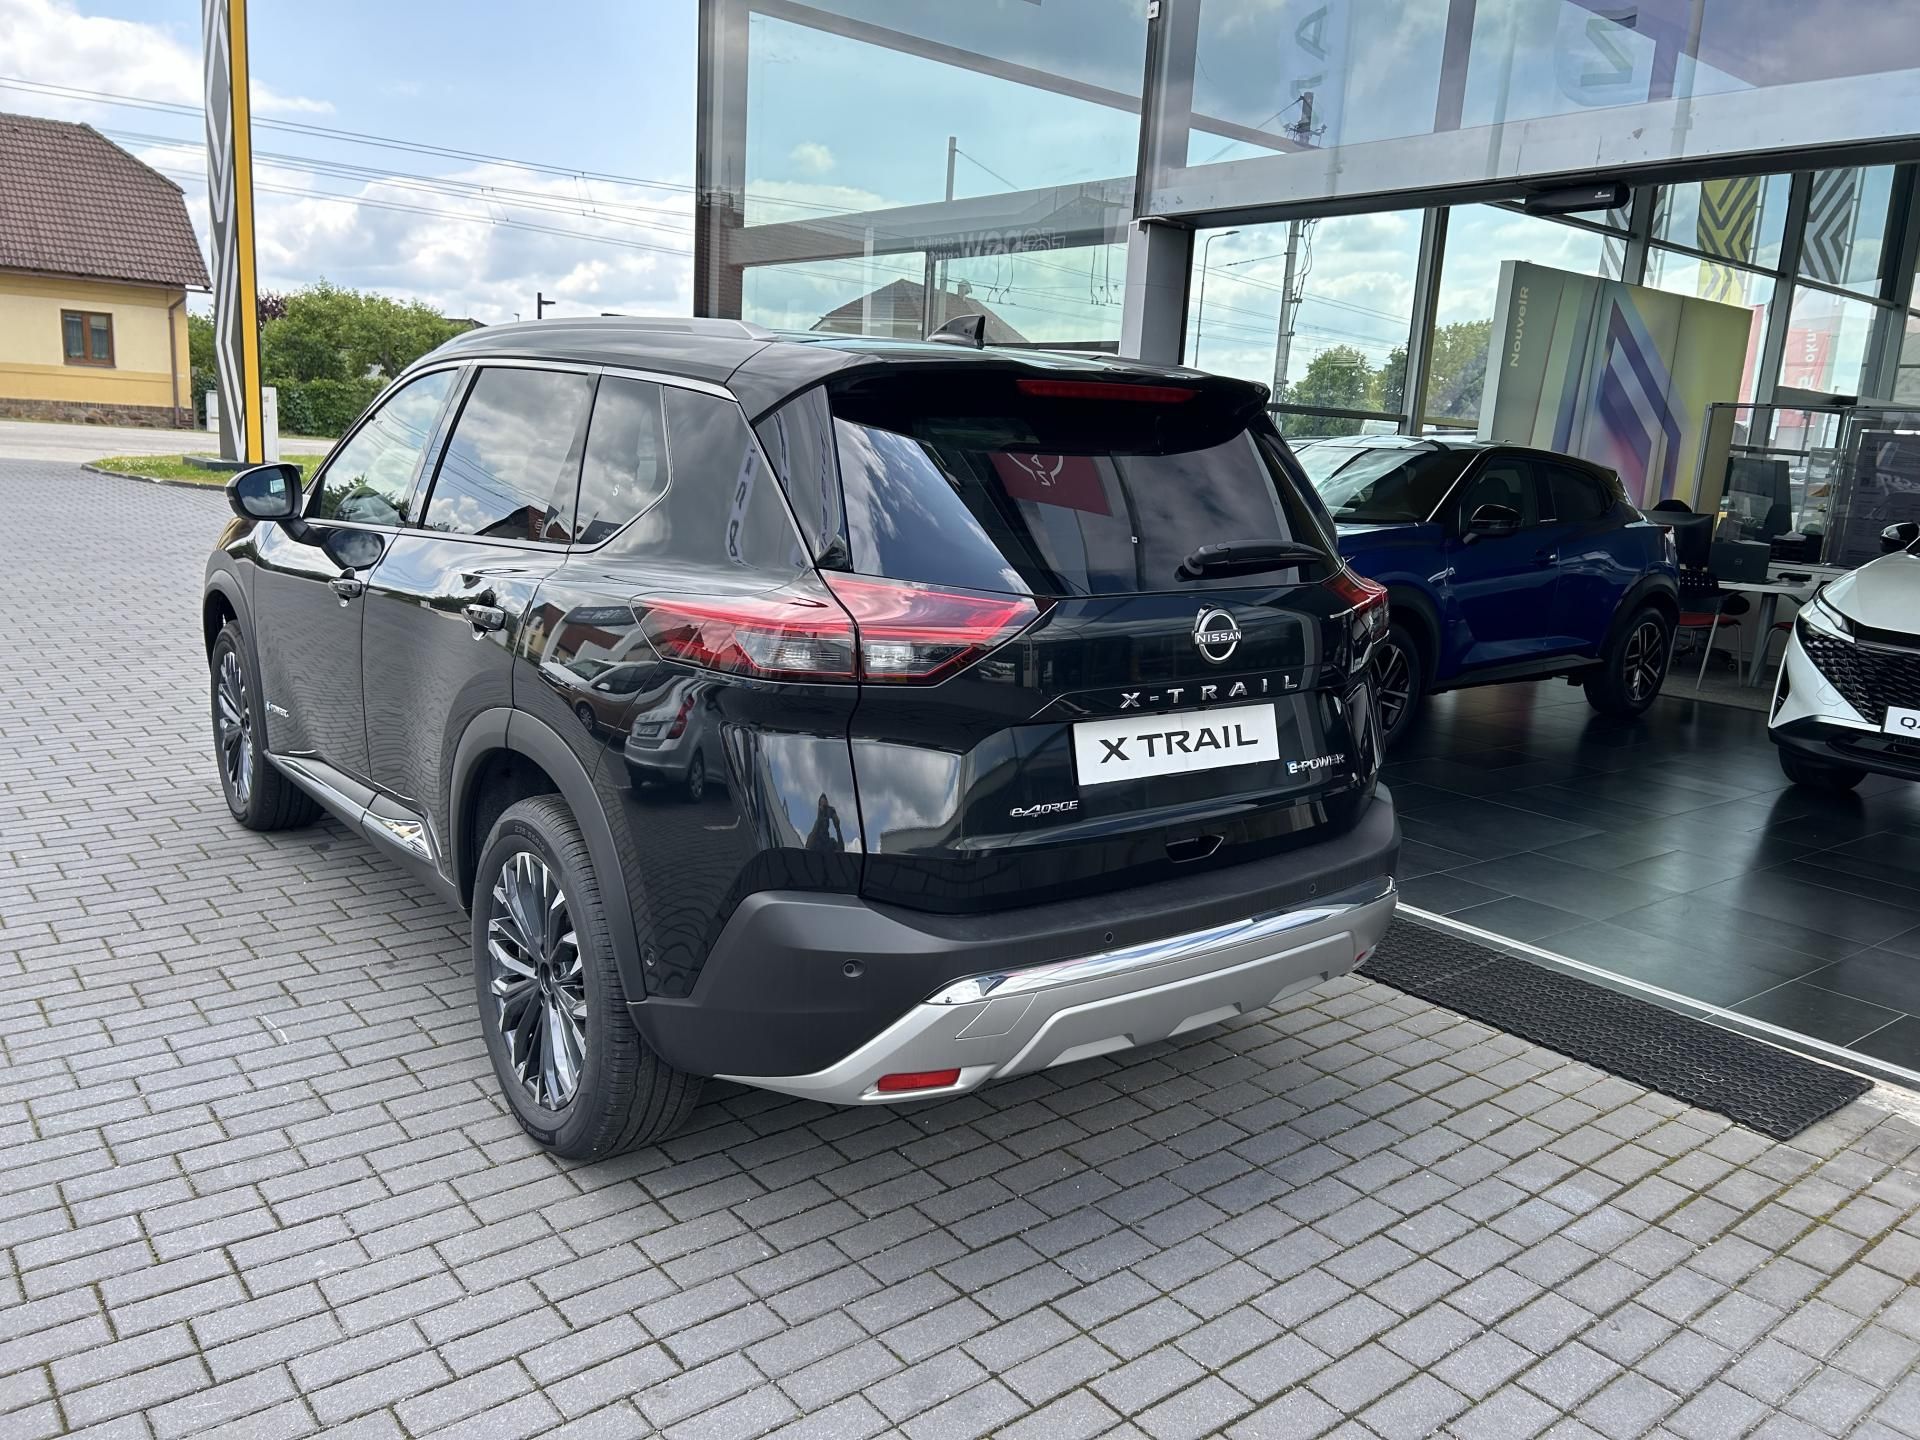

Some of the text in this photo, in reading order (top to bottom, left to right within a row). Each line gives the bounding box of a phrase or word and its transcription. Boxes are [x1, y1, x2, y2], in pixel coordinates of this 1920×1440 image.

[1195, 631, 1242, 644] NISSAN
[1120, 675, 1298, 709] X-TRAIL
[1900, 716, 1920, 730] Q
[1098, 724, 1259, 764] X TRAIL
